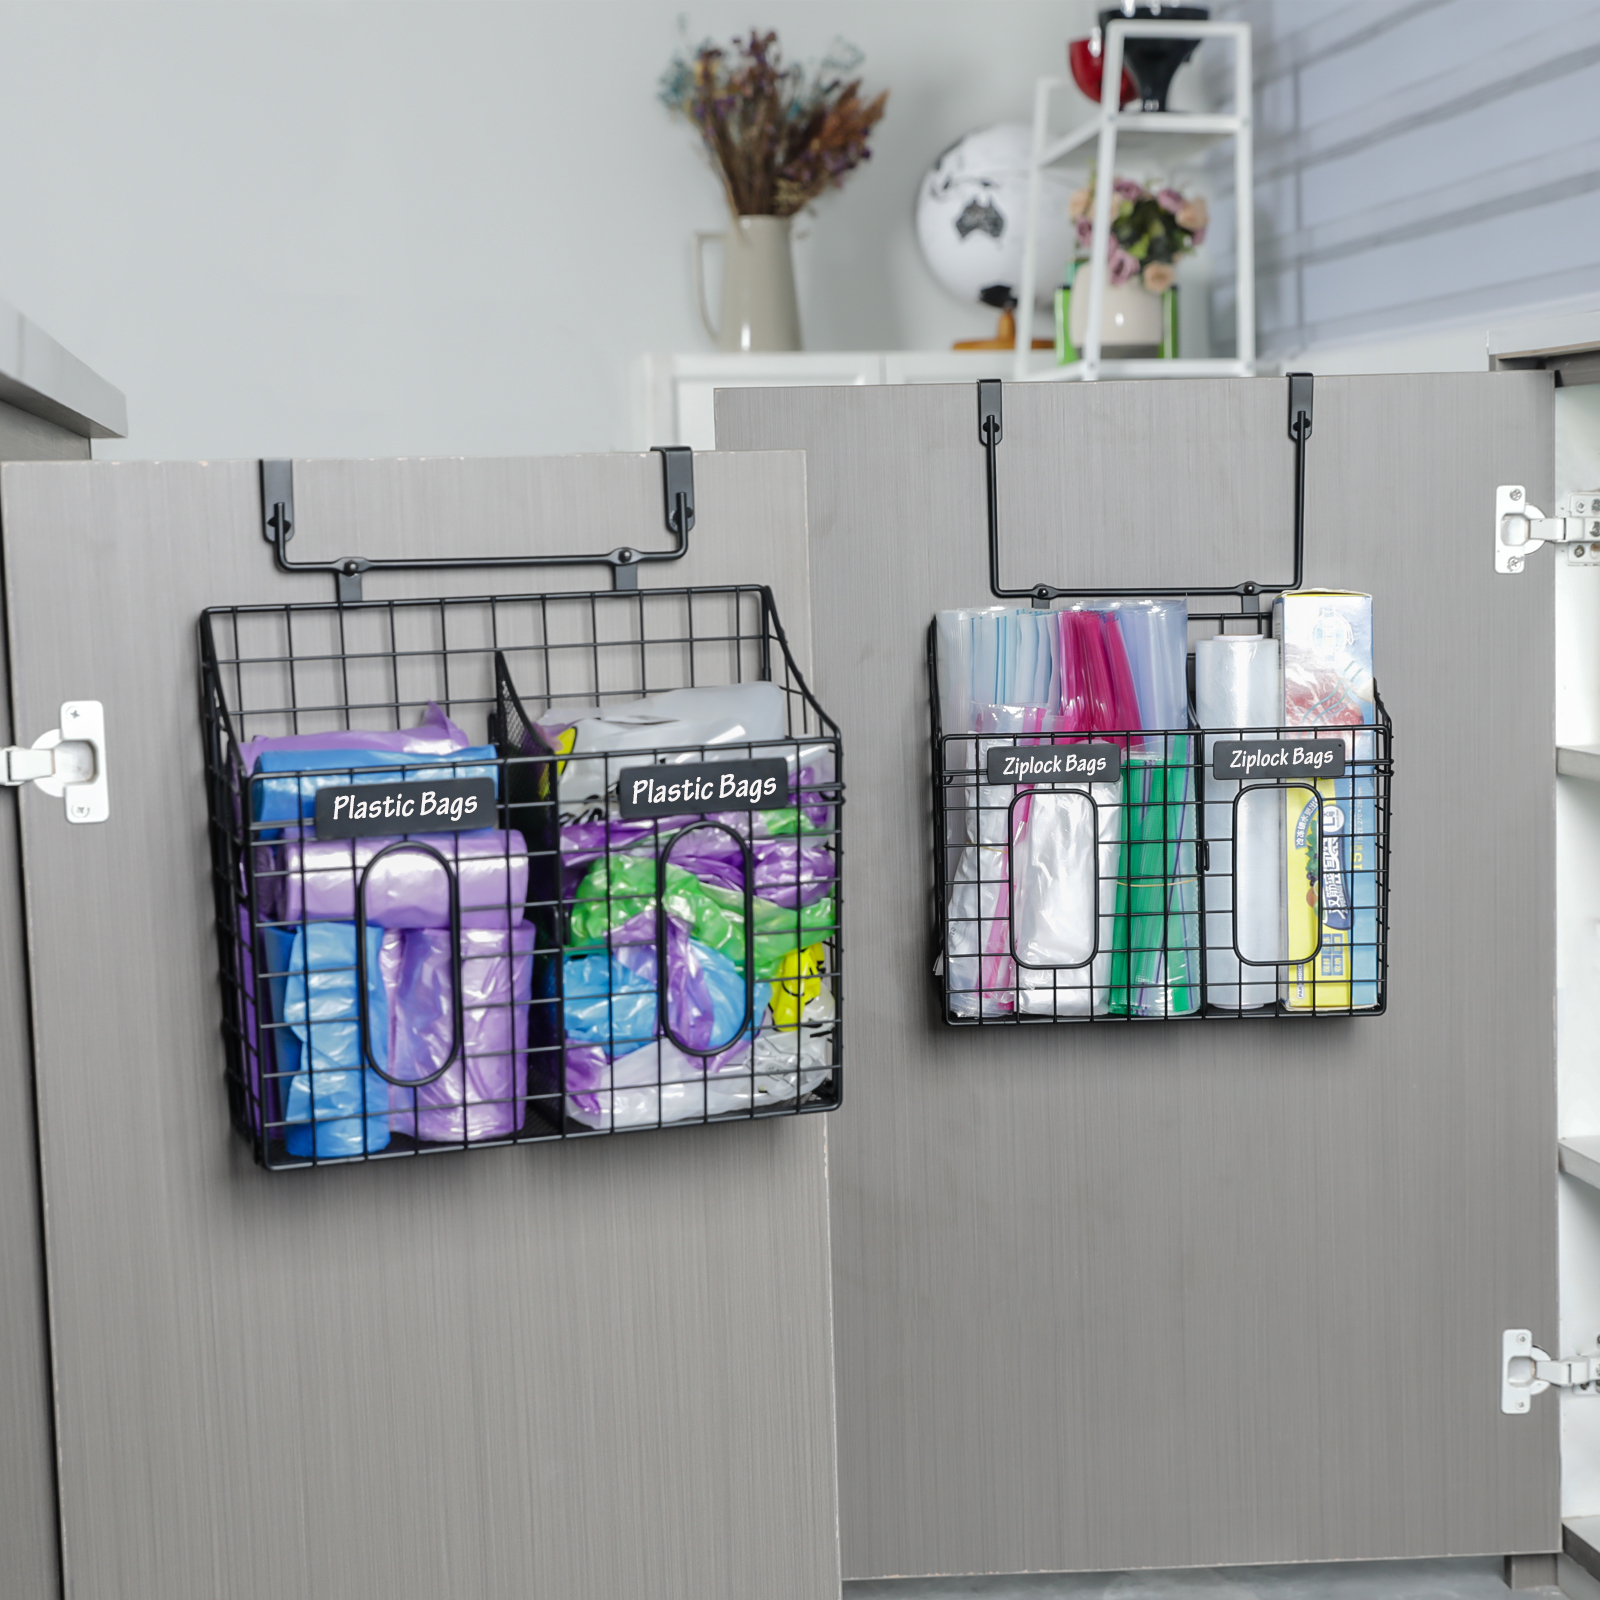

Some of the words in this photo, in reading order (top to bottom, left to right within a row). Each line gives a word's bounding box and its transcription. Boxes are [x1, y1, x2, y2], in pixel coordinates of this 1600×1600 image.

[1003, 755, 1063, 782] Ziplock
[1064, 753, 1107, 777] Bags
[1230, 748, 1290, 775] Ziplock
[1291, 746, 1334, 770] Bags
[633, 777, 714, 804] Plastic
[718, 773, 777, 804] Bags
[333, 793, 415, 820] Plastic
[420, 790, 478, 822] Bags
